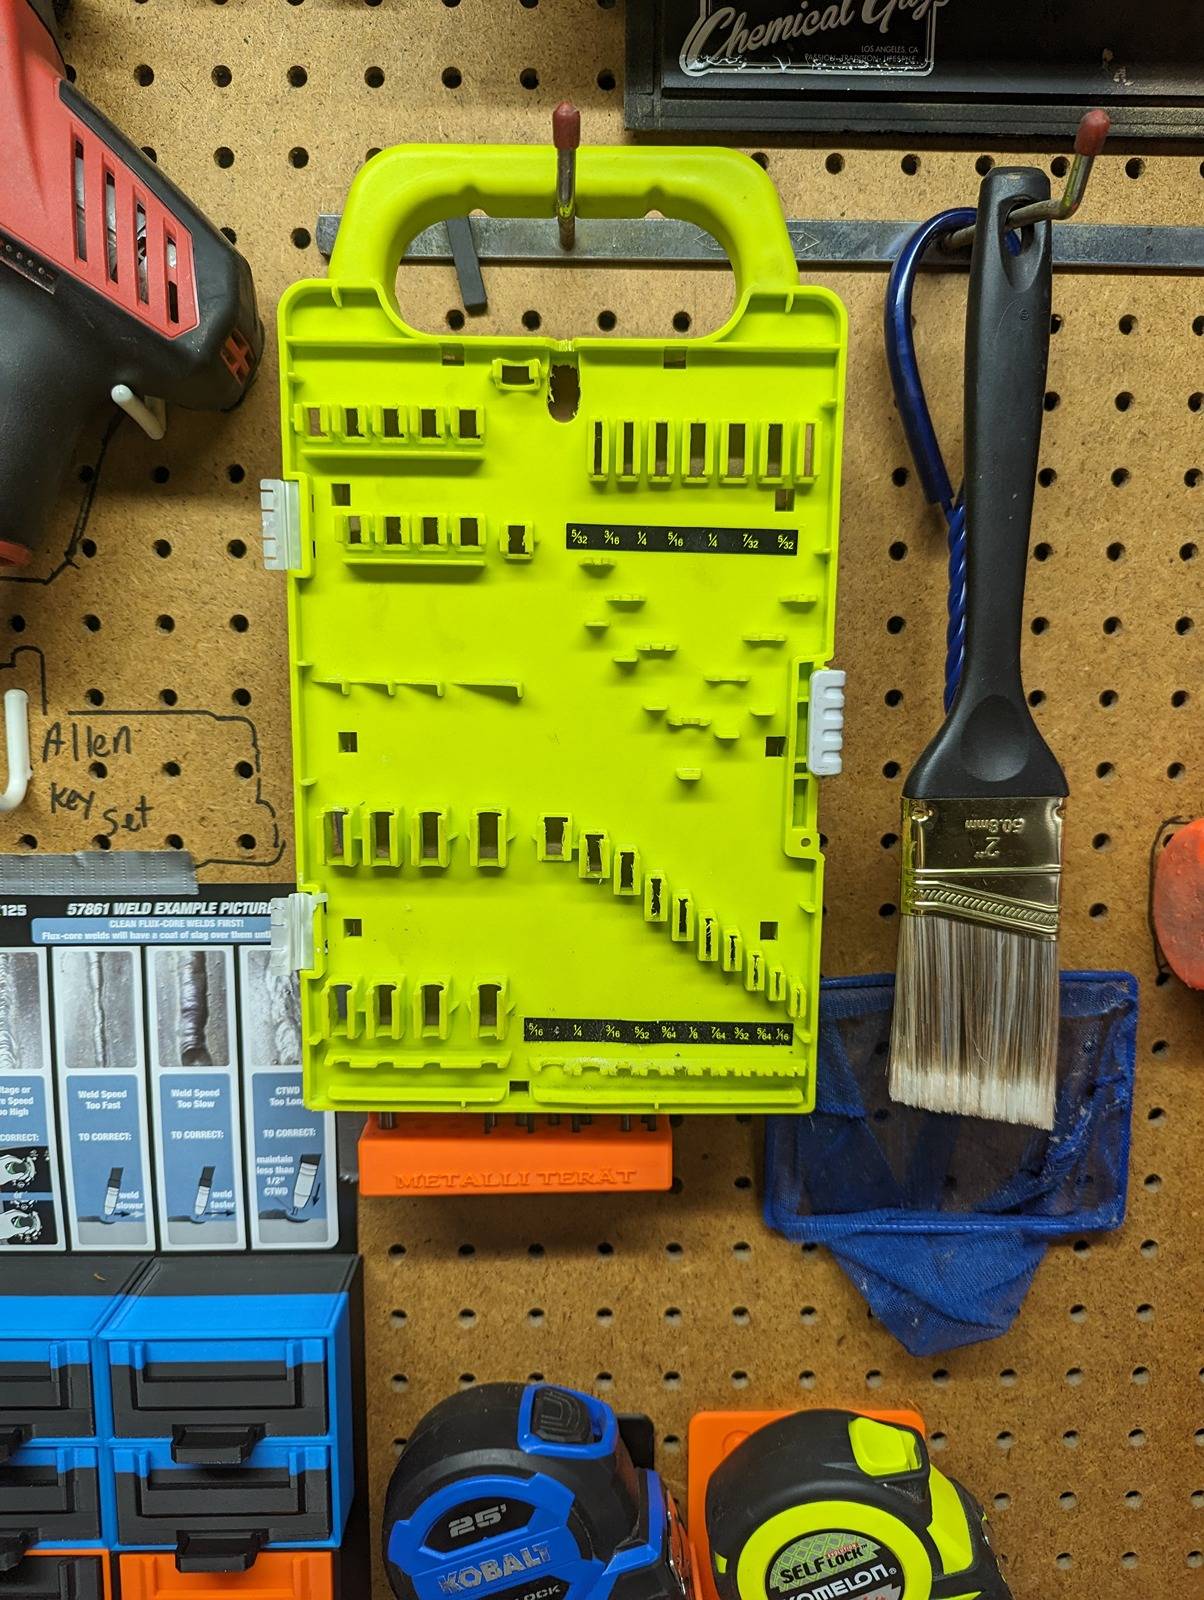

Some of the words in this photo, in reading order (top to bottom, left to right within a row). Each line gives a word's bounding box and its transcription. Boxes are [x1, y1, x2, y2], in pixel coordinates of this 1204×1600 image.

[861, 45, 873, 53] LOS
[571, 529, 588, 544] 5/32
[604, 530, 620, 545] 3/16
[637, 531, 647, 546] 1/4
[667, 532, 684, 547] 5/16
[708, 532, 718, 548] 1/4
[742, 533, 759, 549] 7/32
[777, 534, 794, 550] 5/32
[42, 721, 131, 762] Allen
[66, 902, 110, 916] 57861
[112, 902, 151, 915] WELD
[154, 902, 218, 915] EXAMPLE
[109, 919, 136, 929] CLEAN
[138, 919, 186, 928] FLUX-CORE
[187, 918, 216, 928] WELDS
[218, 918, 245, 928] FIRST!
[42, 931, 84, 941] Flux-core
[85, 931, 110, 941] welds
[112, 931, 128, 941] will
[130, 931, 148, 941] have
[159, 931, 177, 941] coat
[179, 931, 189, 941] of
[190, 931, 208, 941] slag
[210, 931, 229, 941] over
[231, 931, 252, 941] them
[573, 1024, 582, 1037] 1/4
[605, 1024, 620, 1038] 3/16
[78, 1090, 99, 1098] Weld
[100, 1090, 127, 1100] Speed
[171, 1088, 192, 1097] Weld
[194, 1088, 220, 1098] Speed
[276, 1086, 300, 1095] CTWD
[7, 1096, 34, 1106] Speed
[86, 1101, 100, 1109] Too
[102, 1100, 121, 1109] Fast
[177, 1099, 192, 1108] Too
[193, 1099, 215, 1108] Slow
[269, 1098, 285, 1106] Too
[9, 1107, 29, 1117] High
[79, 1133, 90, 1141] TO
[91, 1132, 132, 1141] CORRECT:
[171, 1131, 182, 1139] TO
[183, 1130, 224, 1139] CORRECT:
[263, 1129, 275, 1138] TO
[276, 1127, 317, 1137] CORRECT:
[256, 1154, 294, 1163] maintain
[256, 1166, 274, 1174] less
[275, 1165, 294, 1174] than
[394, 1171, 530, 1189] METALLI
[119, 1191, 139, 1199] weld
[212, 1190, 232, 1198] weld
[264, 1187, 289, 1196] CTWD
[210, 1200, 236, 1209] faster
[448, 1504, 508, 1538] 25'
[437, 1540, 551, 1595] KOBALT
[780, 1556, 825, 1584] SELF
[514, 1584, 561, 1600] OCK
